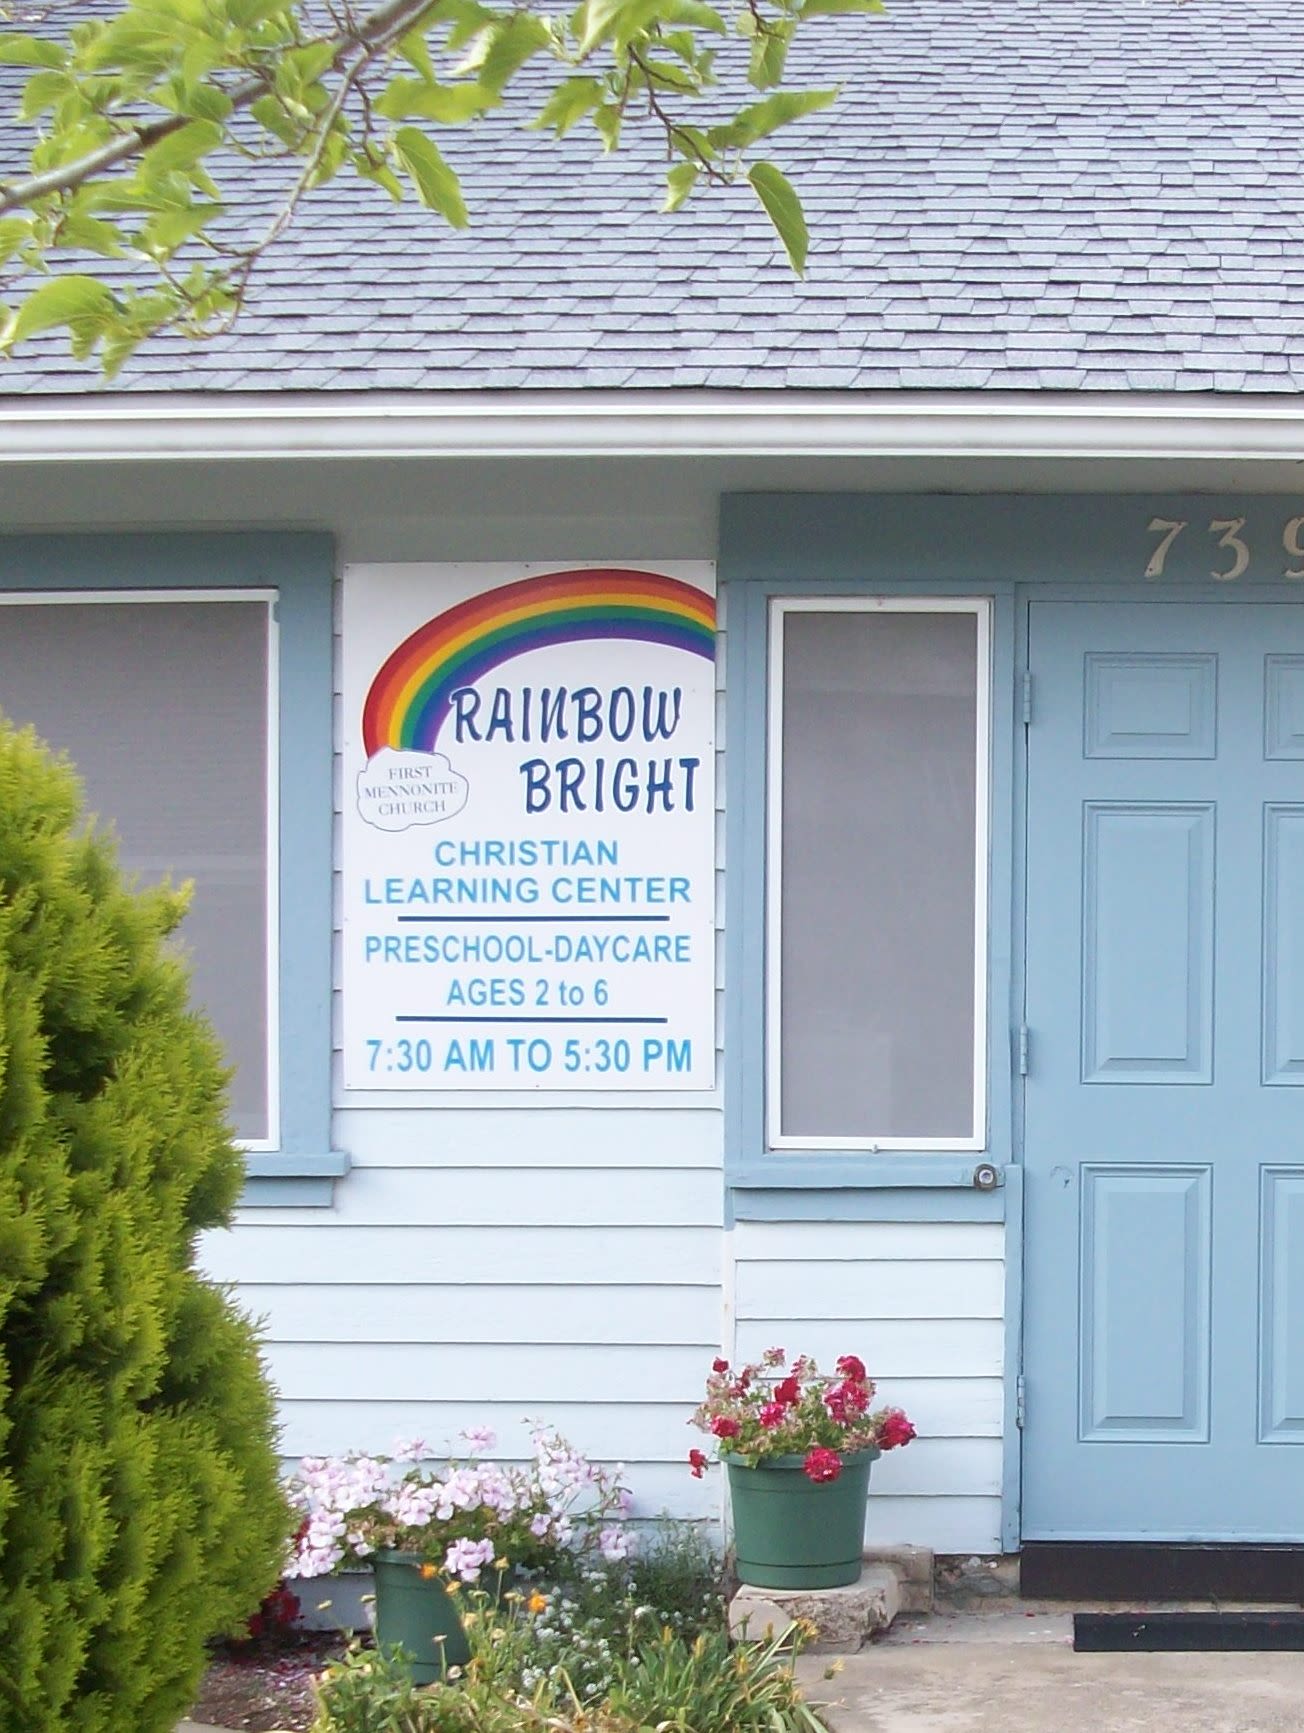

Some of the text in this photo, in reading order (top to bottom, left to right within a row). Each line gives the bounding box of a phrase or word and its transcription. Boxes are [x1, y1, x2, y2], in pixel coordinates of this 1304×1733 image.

[450, 685, 682, 744] RAINBOW
[388, 765, 433, 780] FIRST
[519, 757, 701, 814] BRIGHT
[365, 782, 458, 799] MENNONITE
[378, 800, 446, 817] CHURCH
[434, 839, 619, 867] CHRISTIAN
[364, 876, 692, 904] LEARNING CENTER
[364, 934, 692, 964] PRESCHOOL-DAYCARE
[446, 978, 610, 1007] AGES 2 to 6
[366, 1038, 692, 1073] 7:30 AM TO 5:30 PM
